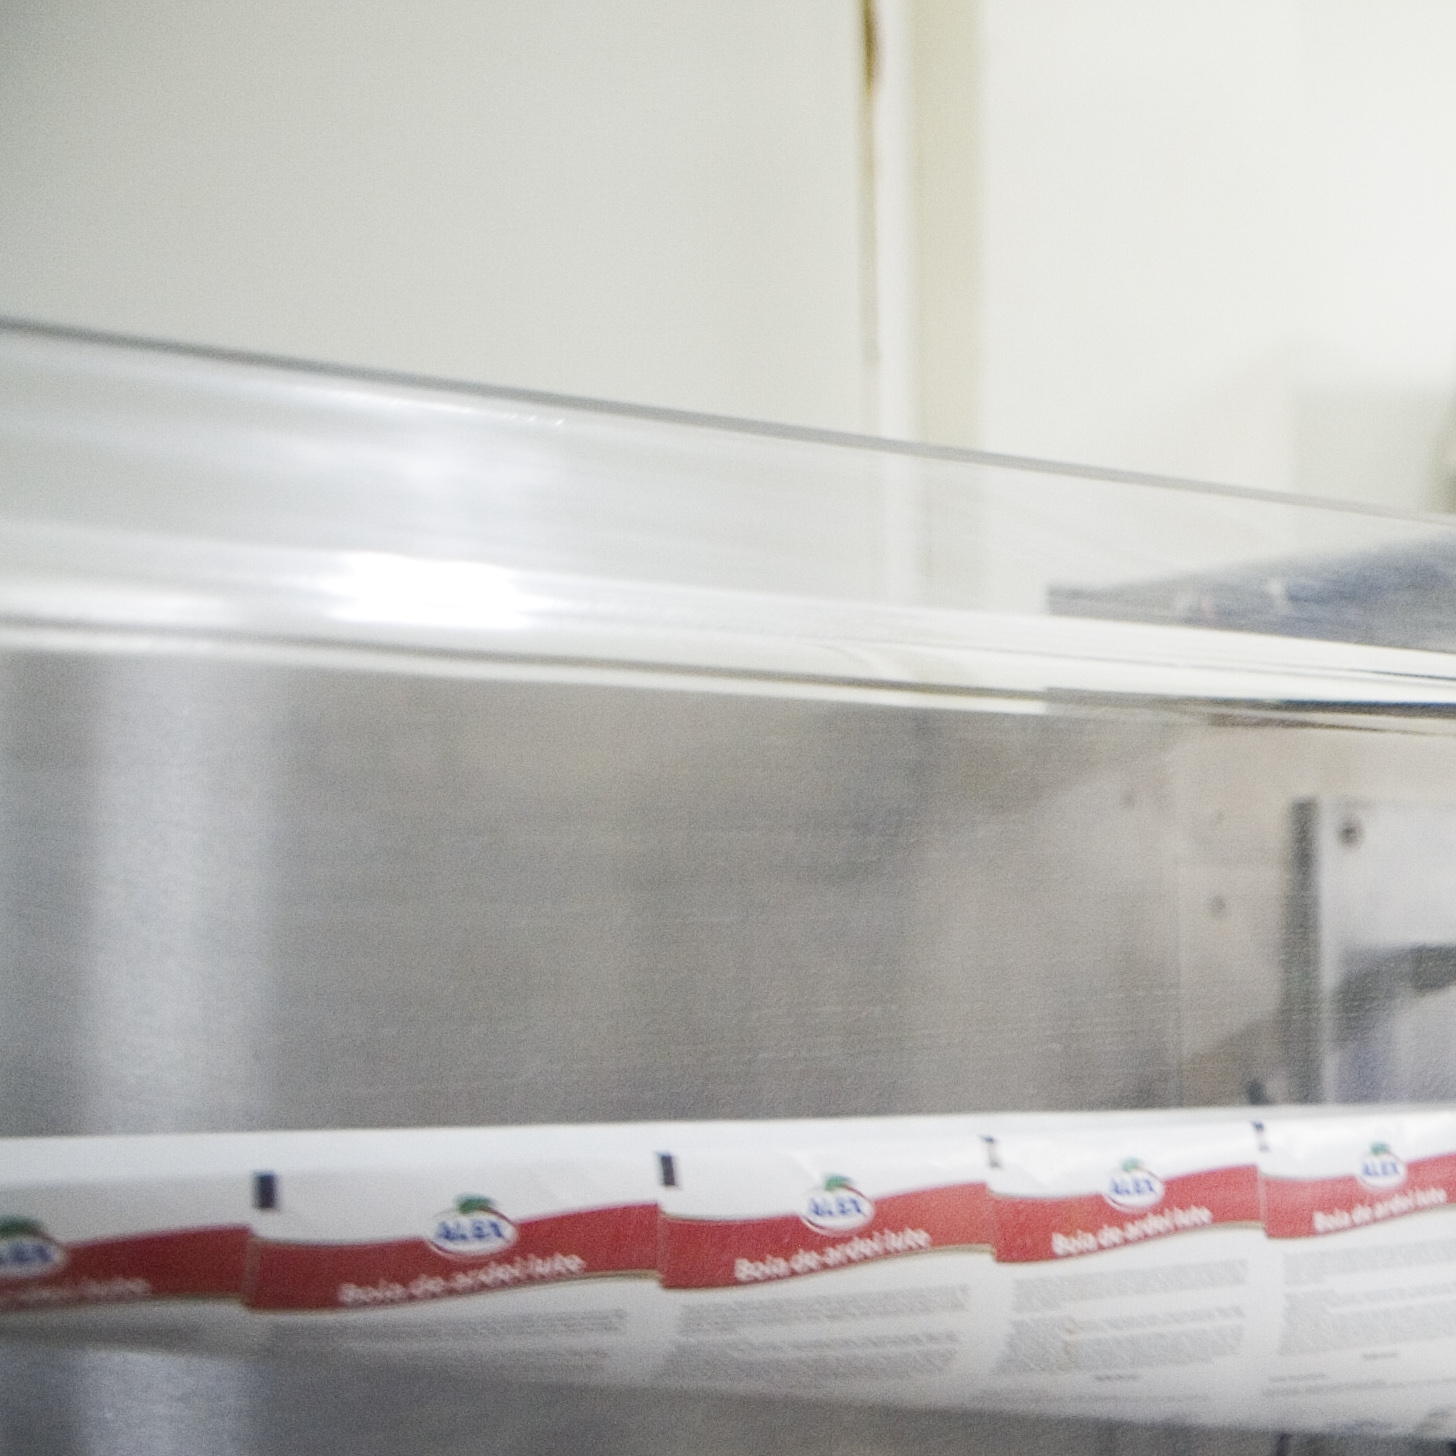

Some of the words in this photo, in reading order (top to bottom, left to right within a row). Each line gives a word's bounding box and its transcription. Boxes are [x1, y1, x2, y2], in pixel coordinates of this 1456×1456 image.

[1361, 1161, 1400, 1177] ALEX
[1109, 1177, 1157, 1196] ALEX
[808, 1197, 868, 1218] ALEX
[434, 1219, 508, 1243] ALEX
